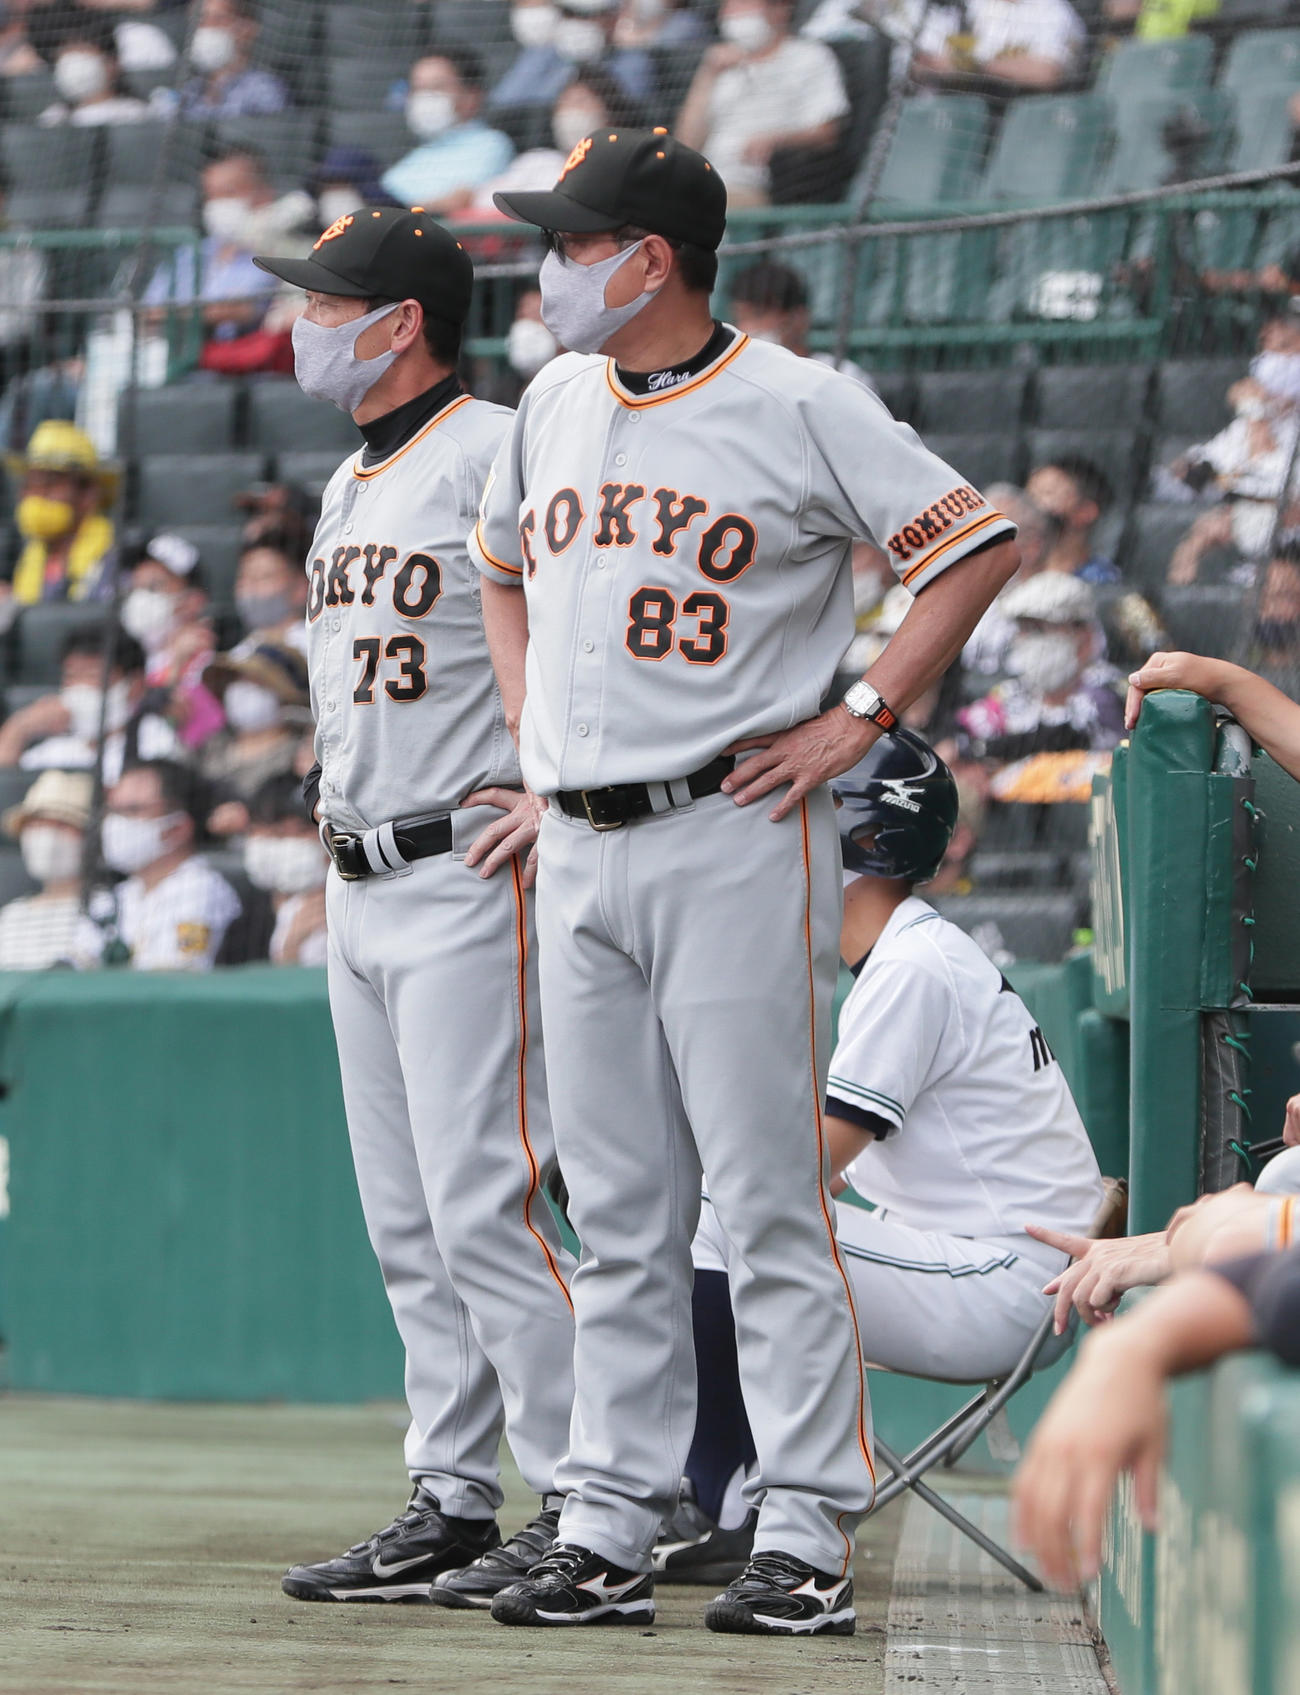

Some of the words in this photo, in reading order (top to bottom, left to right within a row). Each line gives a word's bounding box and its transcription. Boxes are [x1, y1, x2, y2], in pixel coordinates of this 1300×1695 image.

[648, 370, 691, 391] Hara
[519, 482, 758, 584] TOKYO
[307, 543, 444, 624] OKYO
[624, 585, 730, 665] 83
[352, 632, 428, 706] 73
